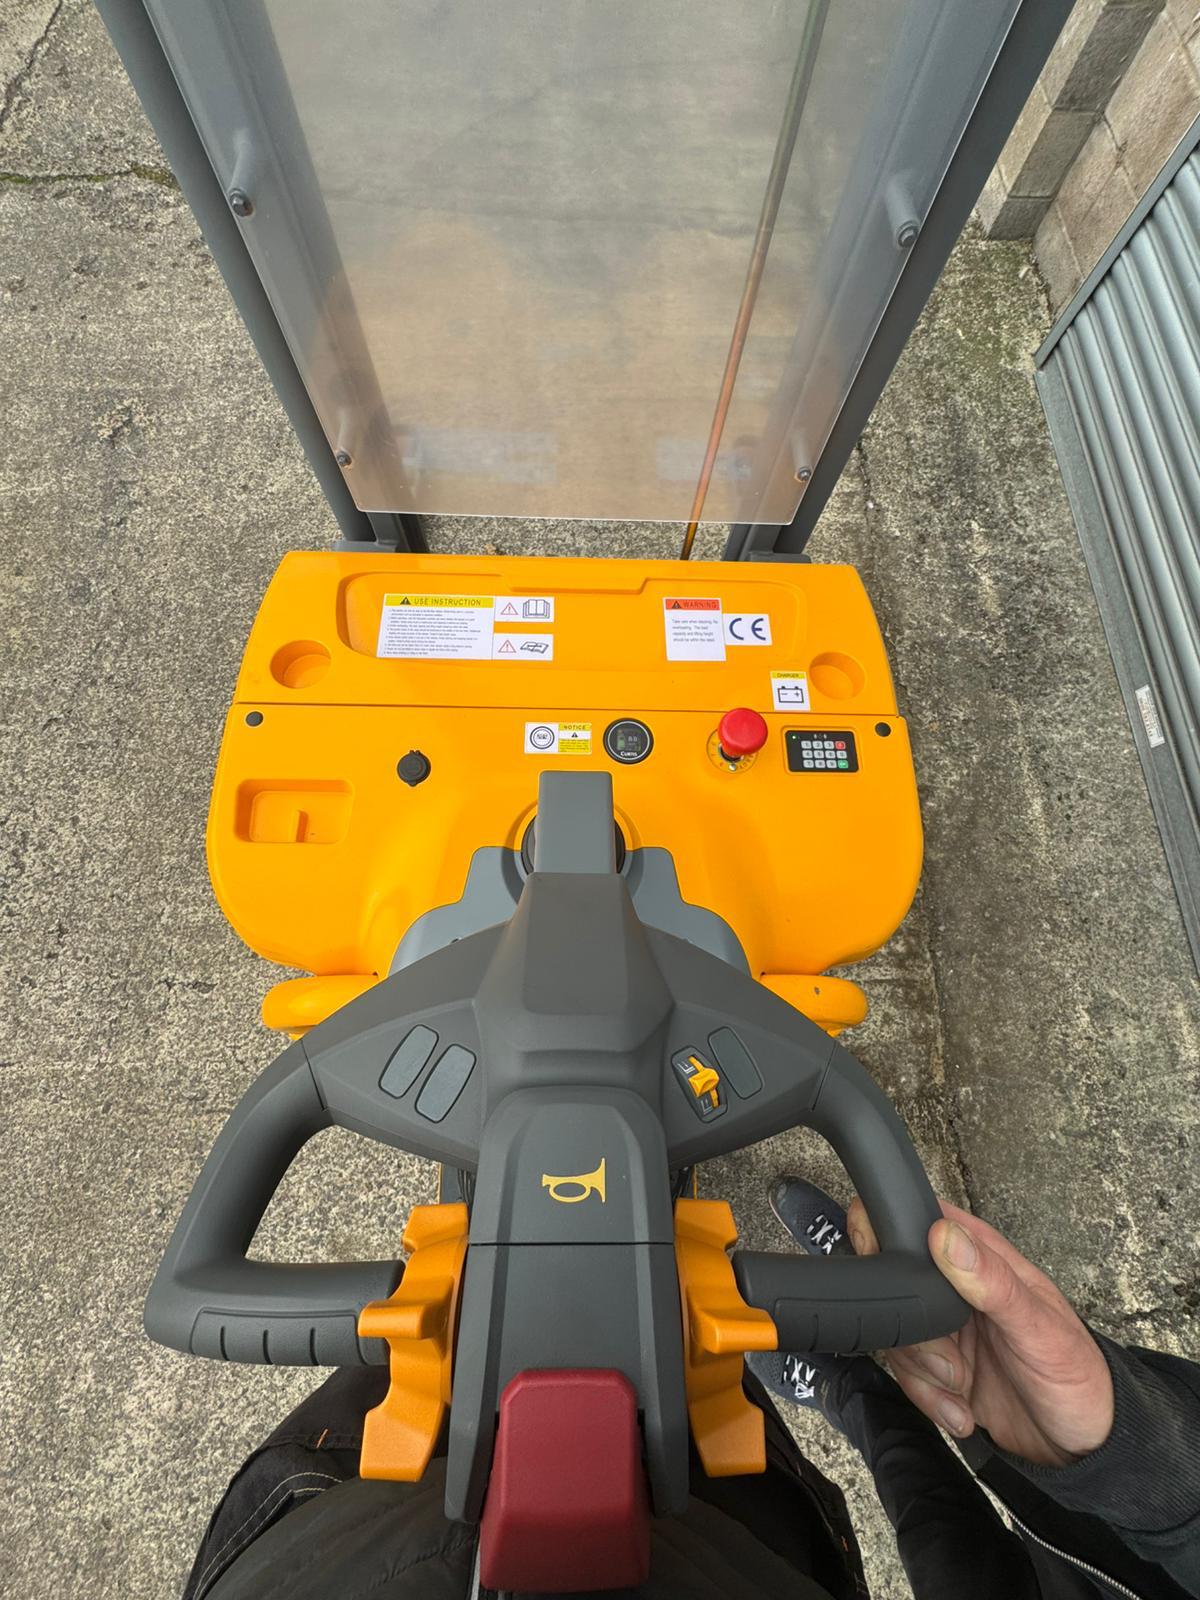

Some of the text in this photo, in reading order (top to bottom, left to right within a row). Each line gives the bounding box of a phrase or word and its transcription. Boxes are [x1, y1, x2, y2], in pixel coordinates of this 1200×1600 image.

[431, 598, 481, 606] INSTRUCTION
[684, 600, 717, 608] WARNING
[729, 617, 767, 641] CE
